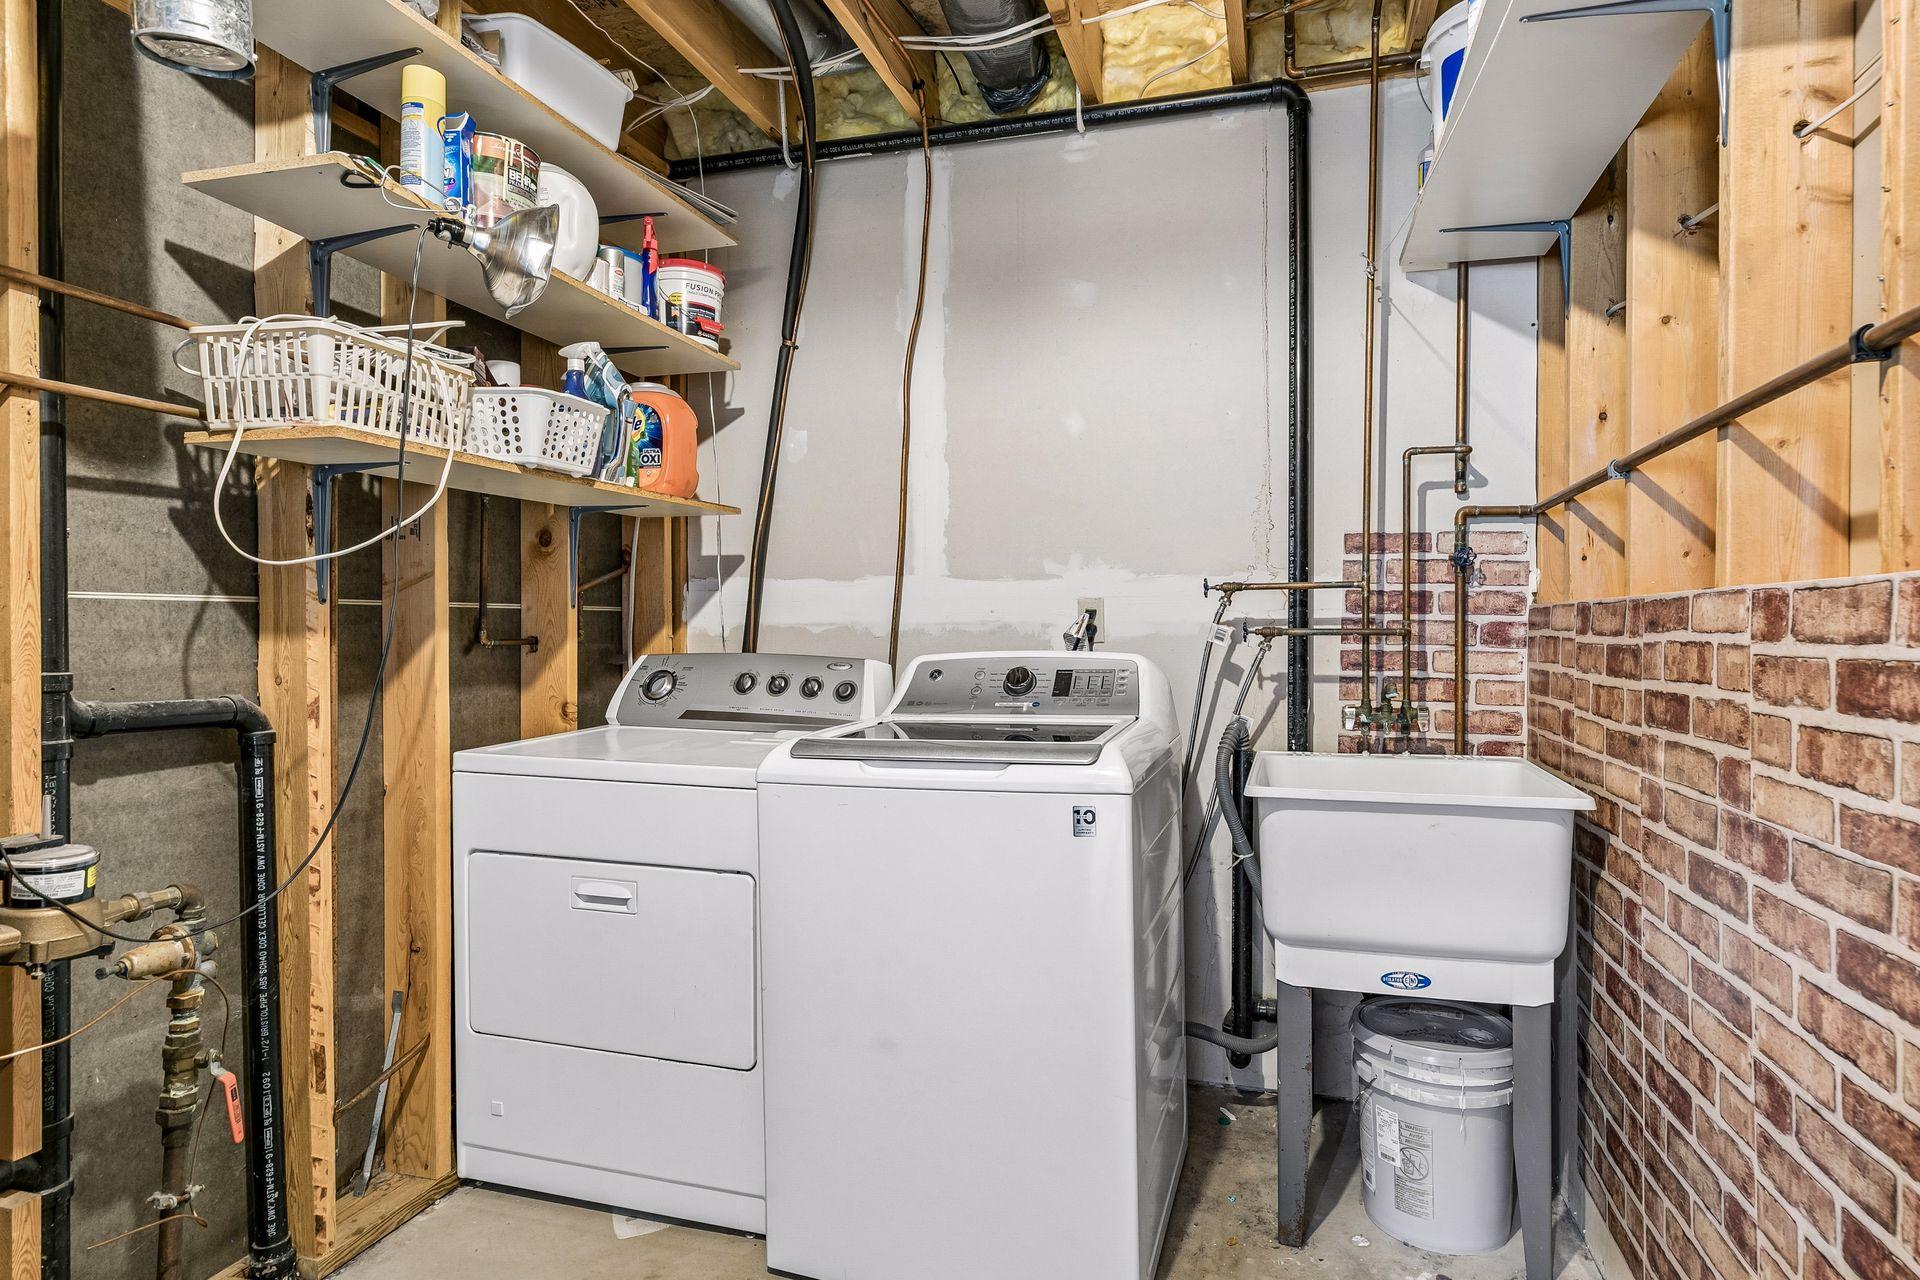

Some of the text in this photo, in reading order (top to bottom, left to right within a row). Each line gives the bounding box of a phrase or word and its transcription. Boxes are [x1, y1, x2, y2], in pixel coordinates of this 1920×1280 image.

[685, 282, 714, 295] FUSION
[641, 454, 661, 464] OXI
[255, 797, 265, 852] ASTM-F628-91
[256, 855, 265, 870] DWV
[256, 872, 266, 890] CORE
[258, 930, 267, 948] COEX
[258, 951, 268, 974] SCH40
[44, 970, 55, 992] CORE
[259, 976, 268, 989] ABS
[44, 995, 55, 1037] CELLULAR
[258, 992, 269, 1036] BRISTOLPIPE
[264, 1148, 275, 1203] ASTM-F628-91
[266, 1205, 276, 1220] DWV
